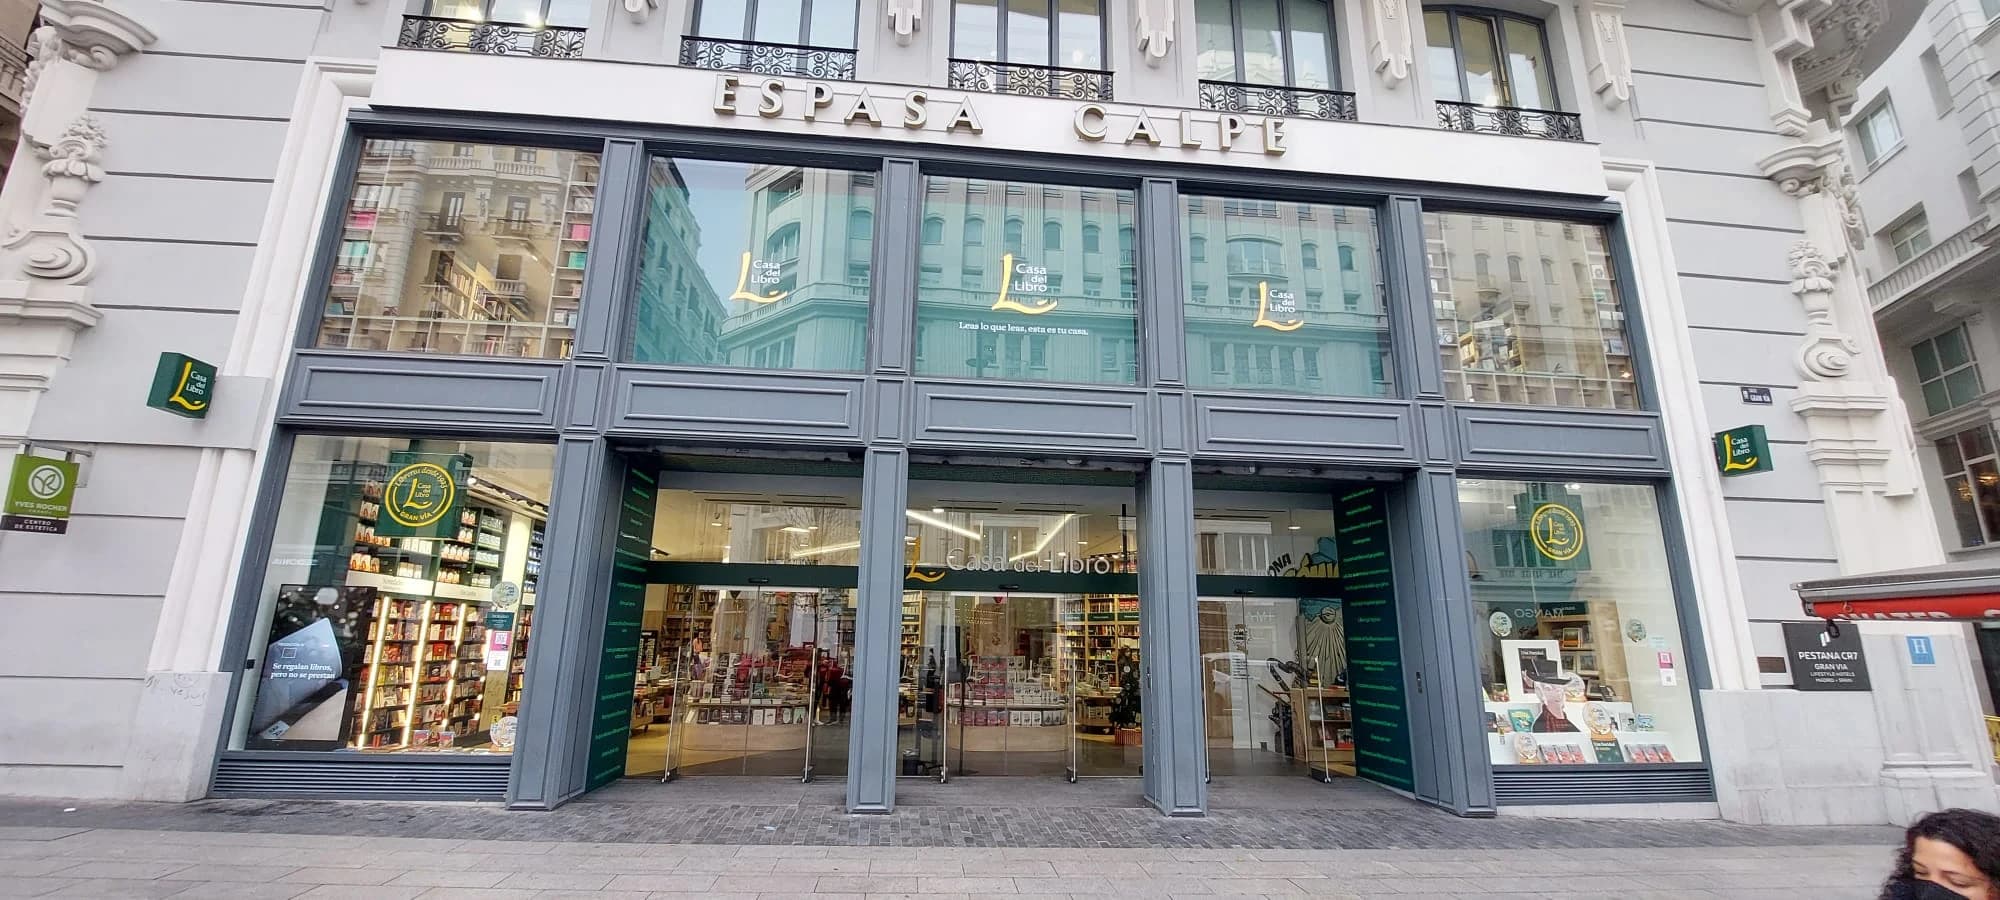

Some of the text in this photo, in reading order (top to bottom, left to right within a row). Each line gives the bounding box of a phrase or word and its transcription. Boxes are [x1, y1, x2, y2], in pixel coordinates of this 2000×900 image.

[713, 75, 1287, 156] ESPASA CALPE
[753, 260, 781, 269] Casa
[1015, 263, 1047, 275] Casa
[766, 269, 781, 277] del
[751, 274, 780, 284] Libro
[1031, 275, 1047, 284] del
[1014, 281, 1047, 293] Libro
[1270, 289, 1294, 299] Casa
[1270, 303, 1296, 313] Libro
[959, 321, 979, 330] Leas
[980, 322, 989, 330] lo
[990, 324, 1007, 332] que
[1028, 325, 1046, 333] esta
[190, 371, 207, 382] Casa
[185, 383, 204, 395] Libro
[196, 381, 206, 389] del
[1731, 437, 1748, 445] Casa
[1732, 448, 1750, 456] Libro
[36, 503, 67, 511] ROCHER
[400, 511, 417, 521] GRAN
[946, 547, 1111, 575] Casa del Libro
[1911, 638, 1929, 654] H
[1799, 651, 1858, 660] PESTANA CR7
[272, 662, 281, 670] Se
[282, 663, 309, 671] regalan
[270, 672, 288, 680] pero
[308, 672, 335, 680] prestan
